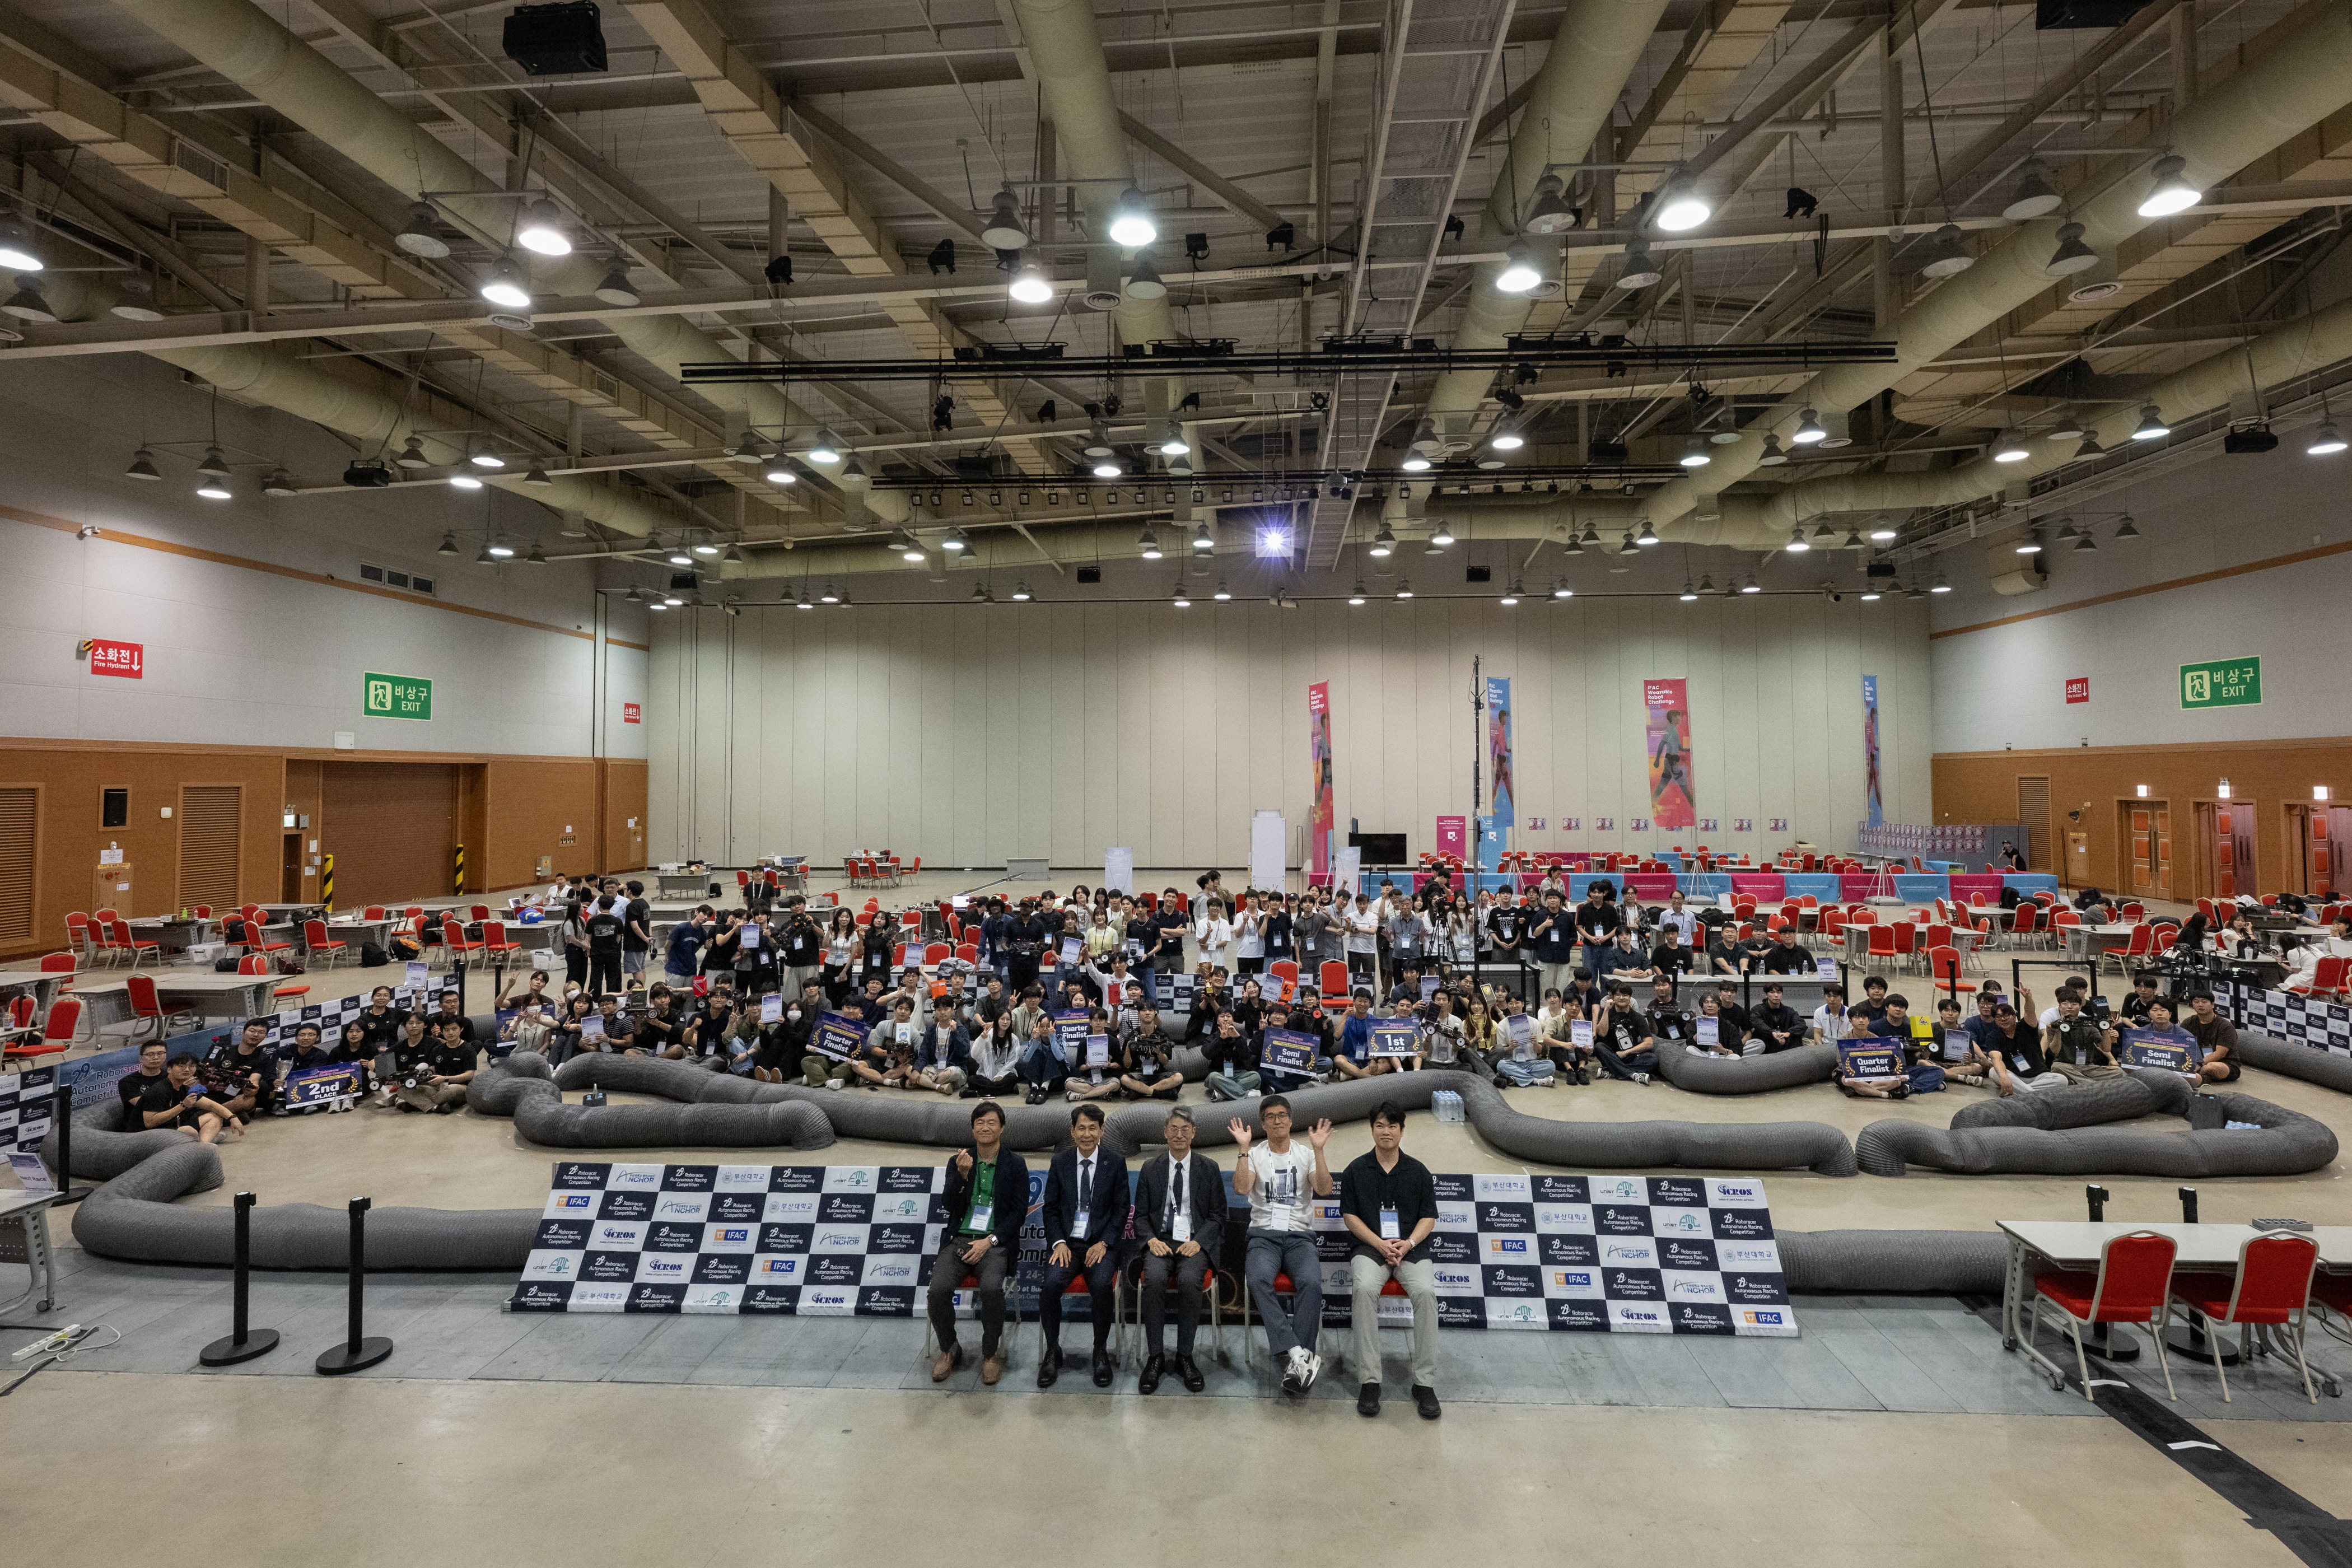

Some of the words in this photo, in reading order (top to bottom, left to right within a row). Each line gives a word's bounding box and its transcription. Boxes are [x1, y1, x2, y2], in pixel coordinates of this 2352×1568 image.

[94, 647, 130, 662] 소화전
[108, 661, 130, 670] Hydrant
[2213, 668, 2254, 685] 비상구
[395, 685, 428, 701] 비상구
[2067, 683, 2082, 694] 소화전
[2222, 685, 2246, 697] EXIT
[402, 701, 421, 712] EXIT
[624, 707, 636, 716] 소화전
[825, 1032, 853, 1047] Quarter
[1385, 1034, 1405, 1046] 1st
[823, 1039, 849, 1053] Finalist
[1282, 1048, 1300, 1058] Semi
[2147, 1049, 2171, 1059] Semi
[1277, 1054, 1304, 1066] Finalist
[2142, 1056, 2176, 1067] Finalist
[96, 1063, 143, 1081] Roboracer
[72, 1079, 120, 1096] Autonomo
[309, 1081, 340, 1096] 2nd
[315, 1091, 337, 1100] PLACE
[1758, 1314, 1779, 1322] IFAC
